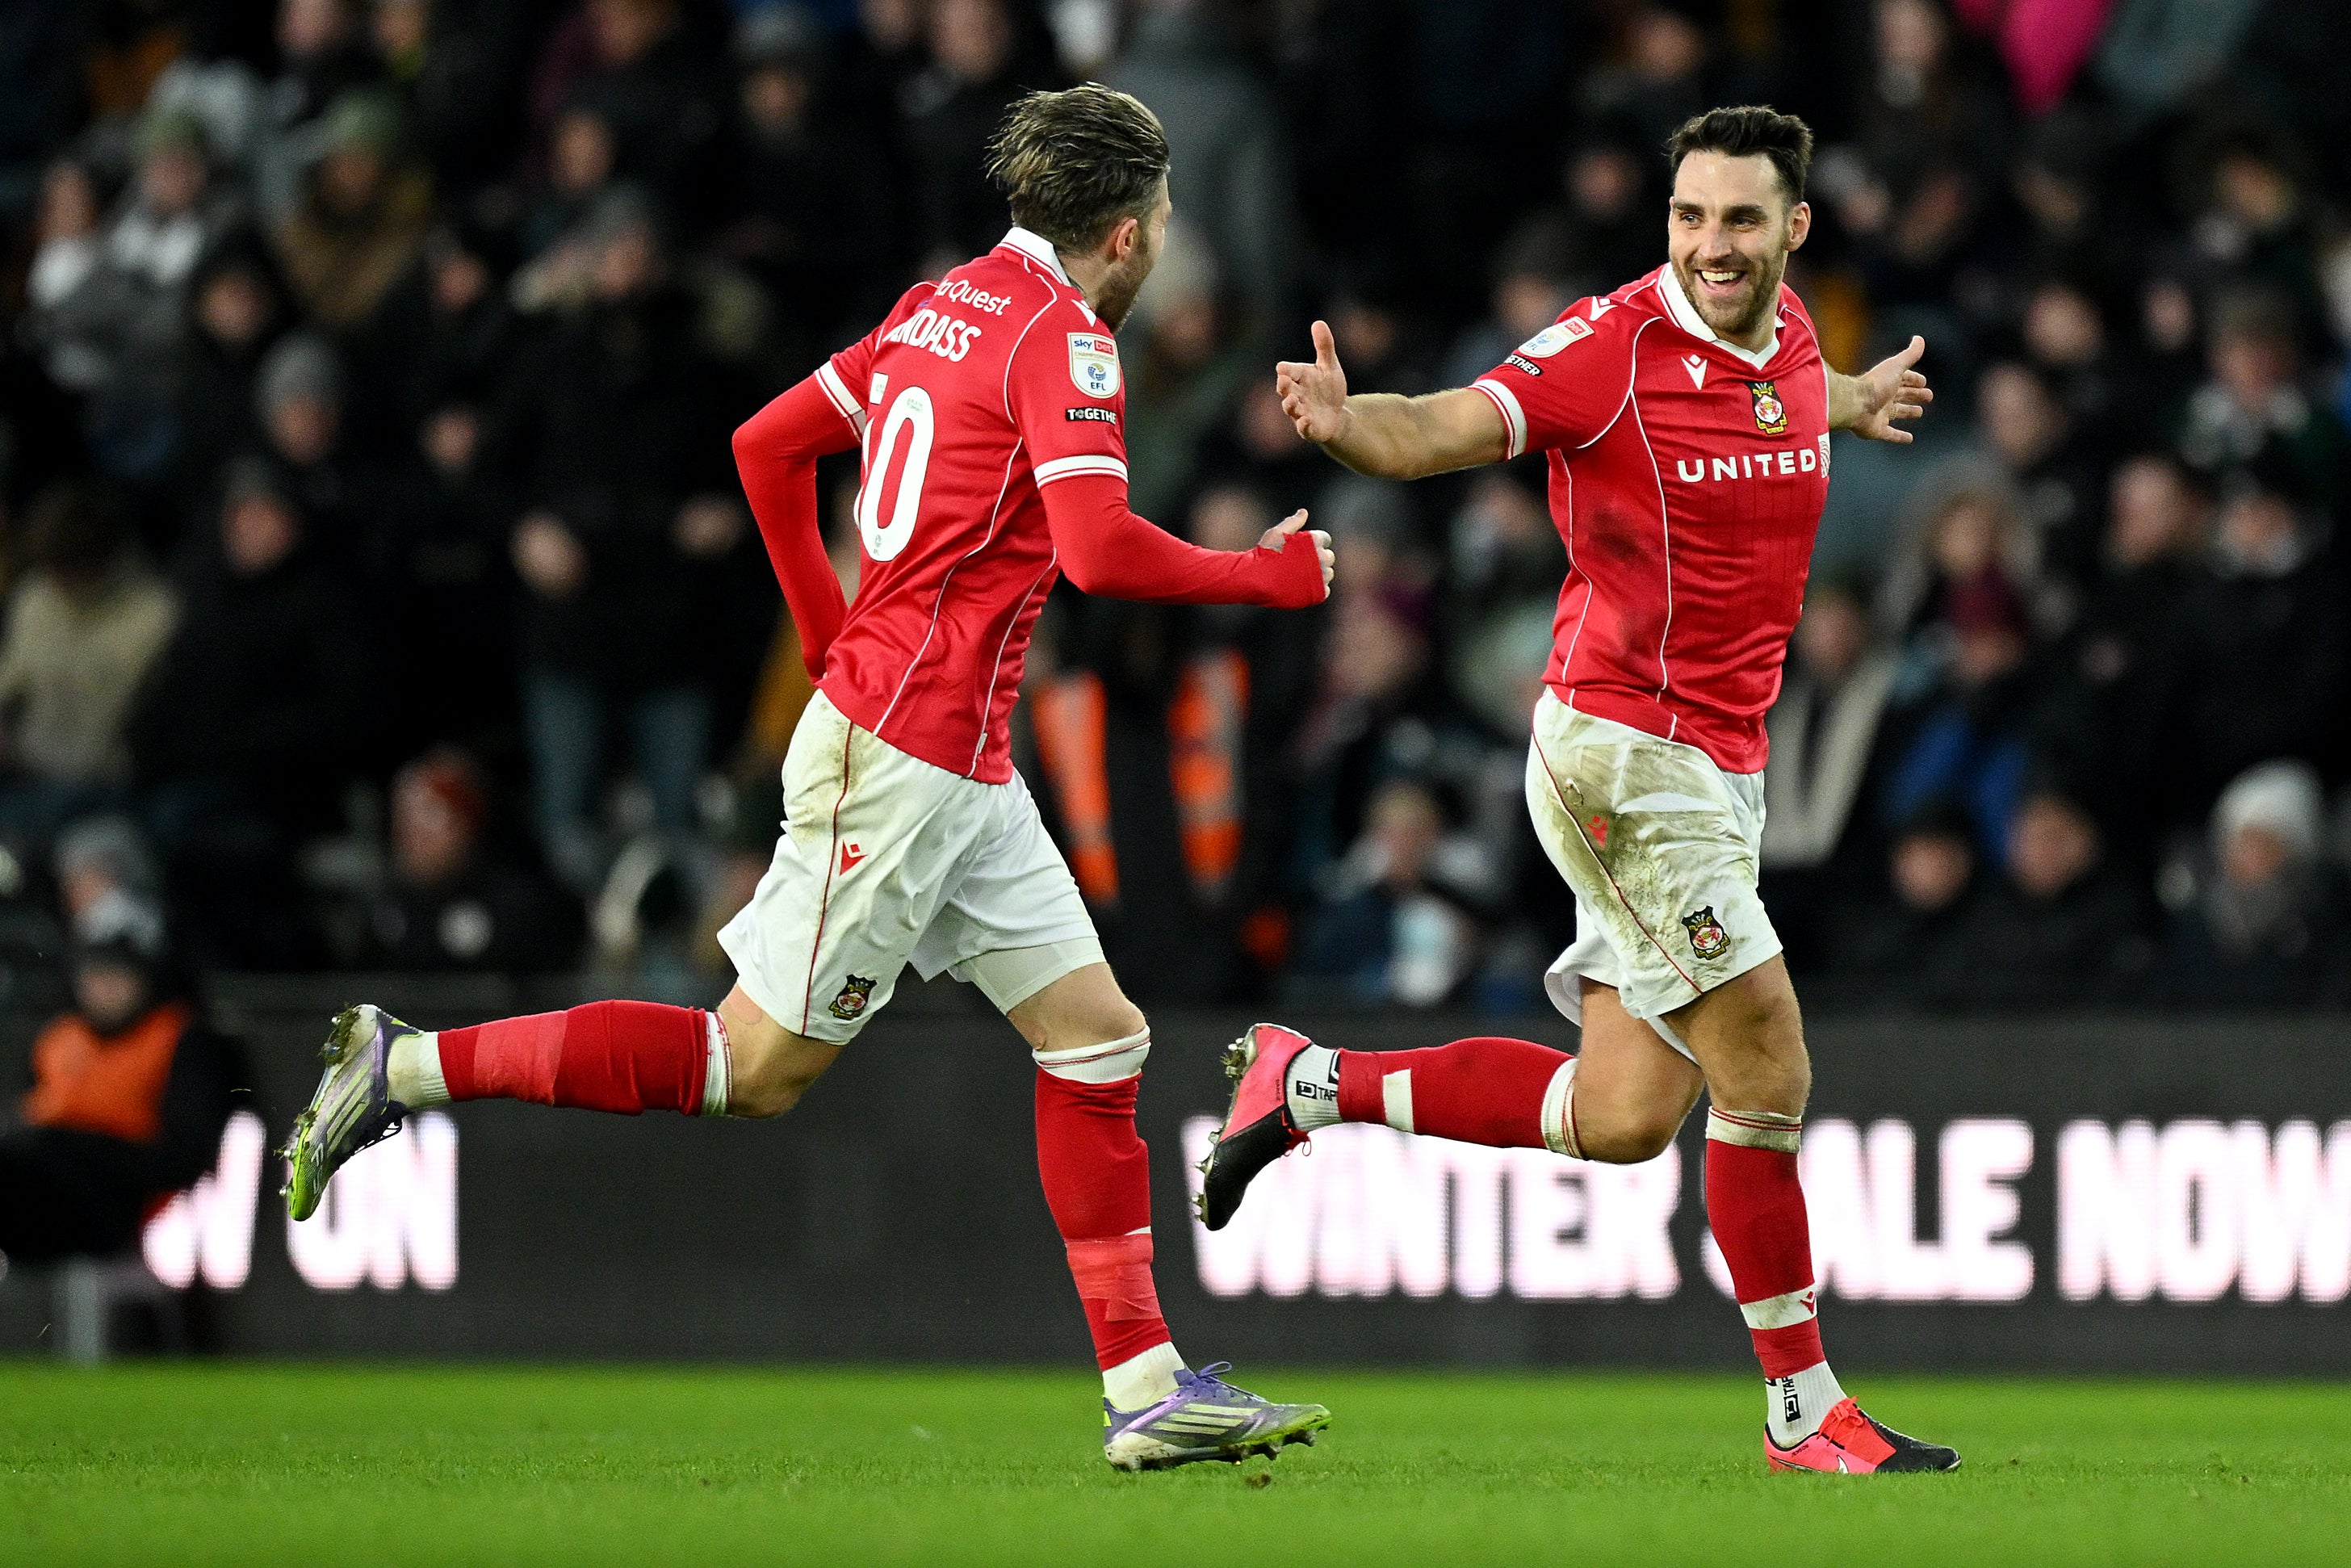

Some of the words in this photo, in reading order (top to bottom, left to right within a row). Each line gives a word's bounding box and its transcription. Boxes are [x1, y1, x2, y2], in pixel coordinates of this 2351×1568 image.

[1074, 339, 1092, 350] sky
[1096, 341, 1113, 354] bet
[1091, 383, 1106, 391] EFL
[1677, 449, 1817, 483] UNITED
[1181, 1115, 1681, 1298] WINTER
[2057, 1119, 2351, 1302] NOW
